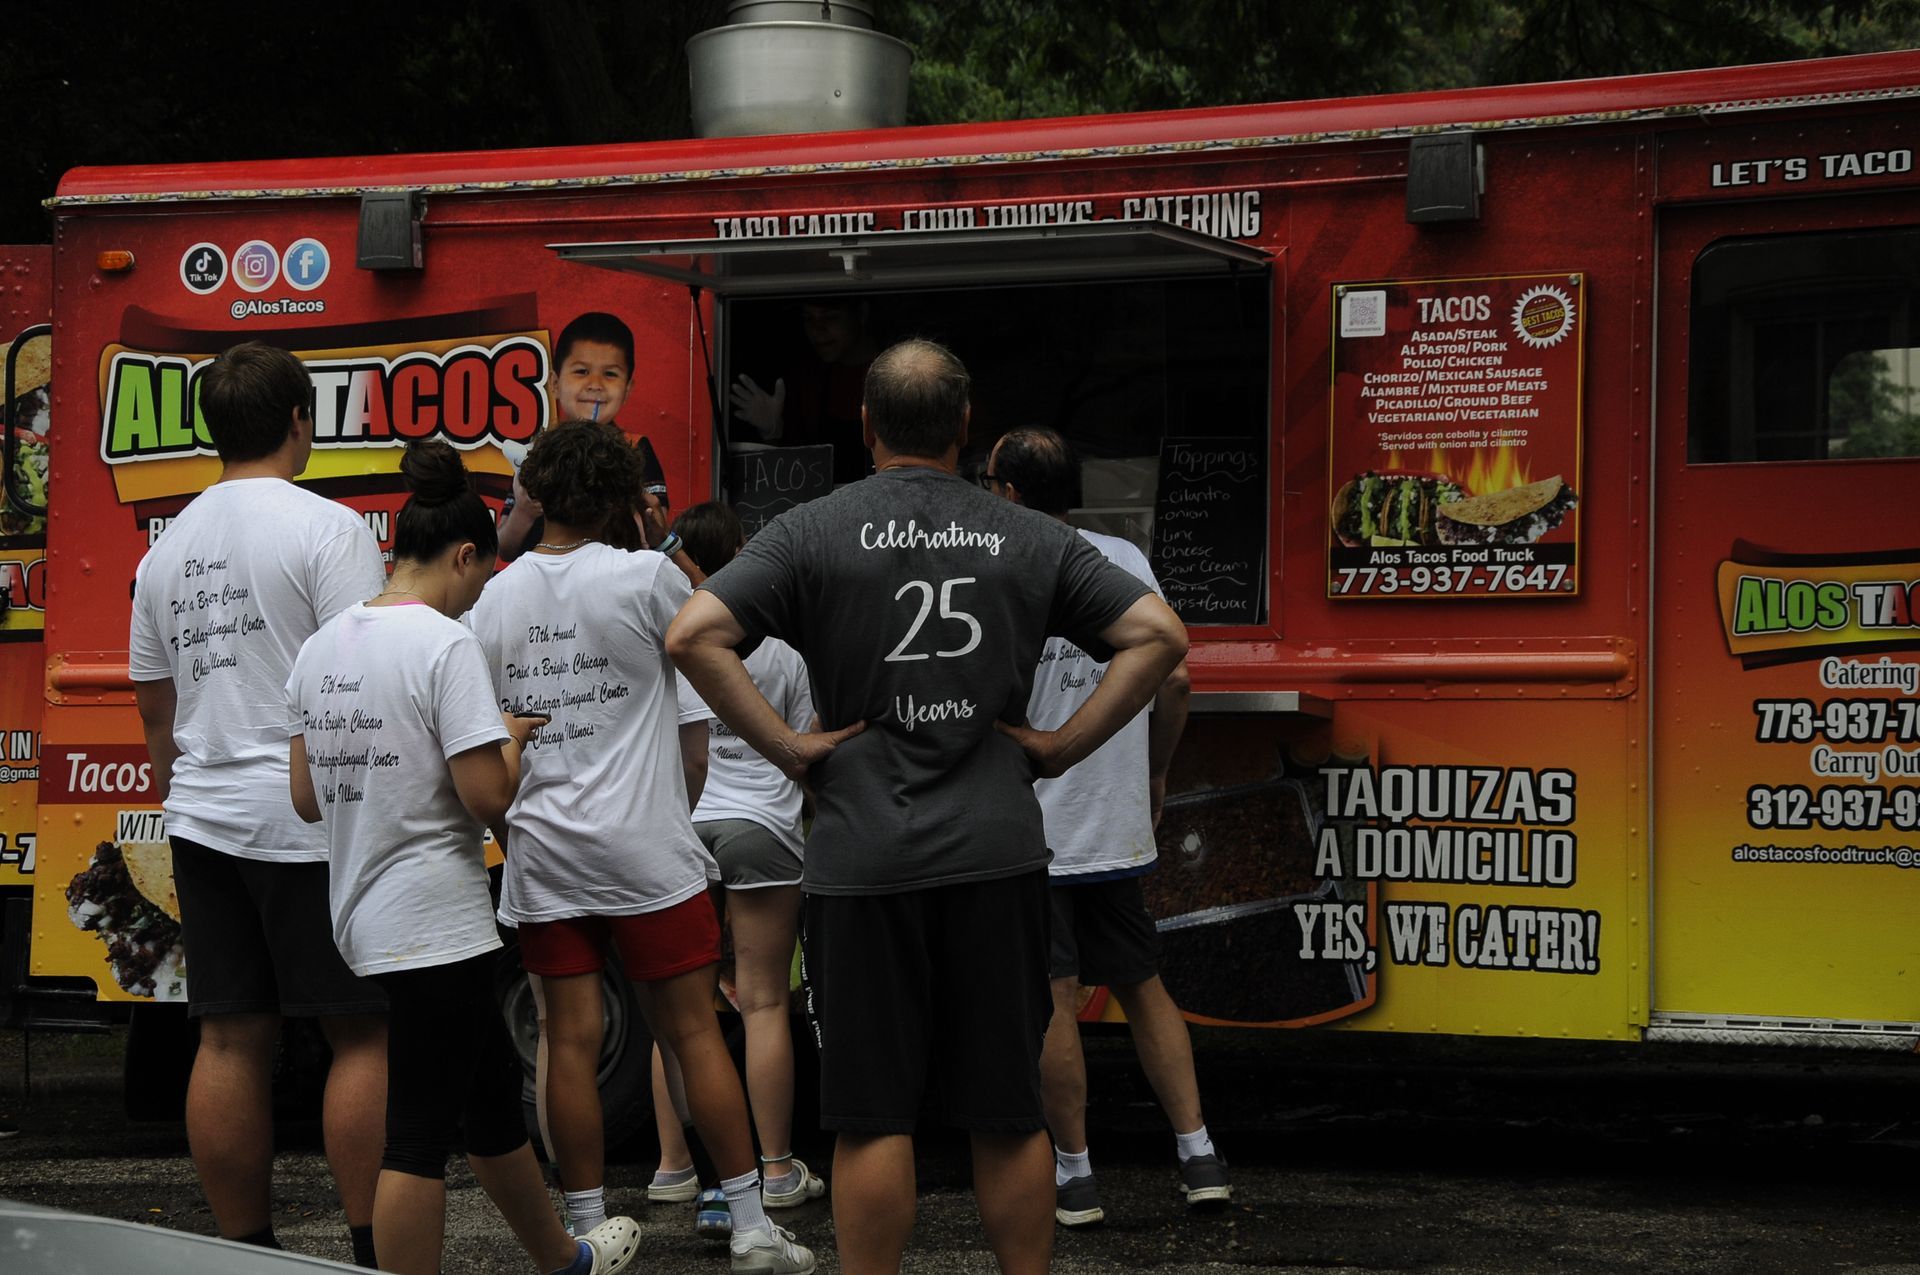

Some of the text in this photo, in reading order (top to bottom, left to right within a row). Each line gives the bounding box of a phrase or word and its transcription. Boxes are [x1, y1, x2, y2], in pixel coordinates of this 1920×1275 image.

[1712, 149, 1912, 187] LET'S TACO
[230, 299, 324, 319] @AlosTacos
[1417, 295, 1491, 324] TACOS
[308, 346, 542, 442] TACOS
[731, 451, 825, 494] TACOS
[1167, 444, 1258, 473] Toppings
[860, 519, 1006, 556] Celebrating
[1370, 548, 1535, 565] Alos Tacos Food Truck
[1338, 564, 1567, 594] 773-937-7647
[883, 576, 983, 662] 25
[1735, 577, 1848, 634] ALOS
[241, 613, 267, 636] Center
[528, 624, 549, 643] 27th
[573, 652, 609, 676] Chicago
[1821, 658, 1917, 691] Catering
[600, 681, 629, 704] Center
[895, 694, 977, 732] Years
[716, 746, 743, 760] Illinois
[1813, 747, 1877, 780] Carry
[66, 753, 151, 793] Tacos
[1317, 767, 1575, 824] TAQUIZAS
[1750, 788, 1920, 827] 312-937-9
[1314, 827, 1576, 885] A DOMICILIO
[1293, 902, 1598, 972] YES, WE CATER!
